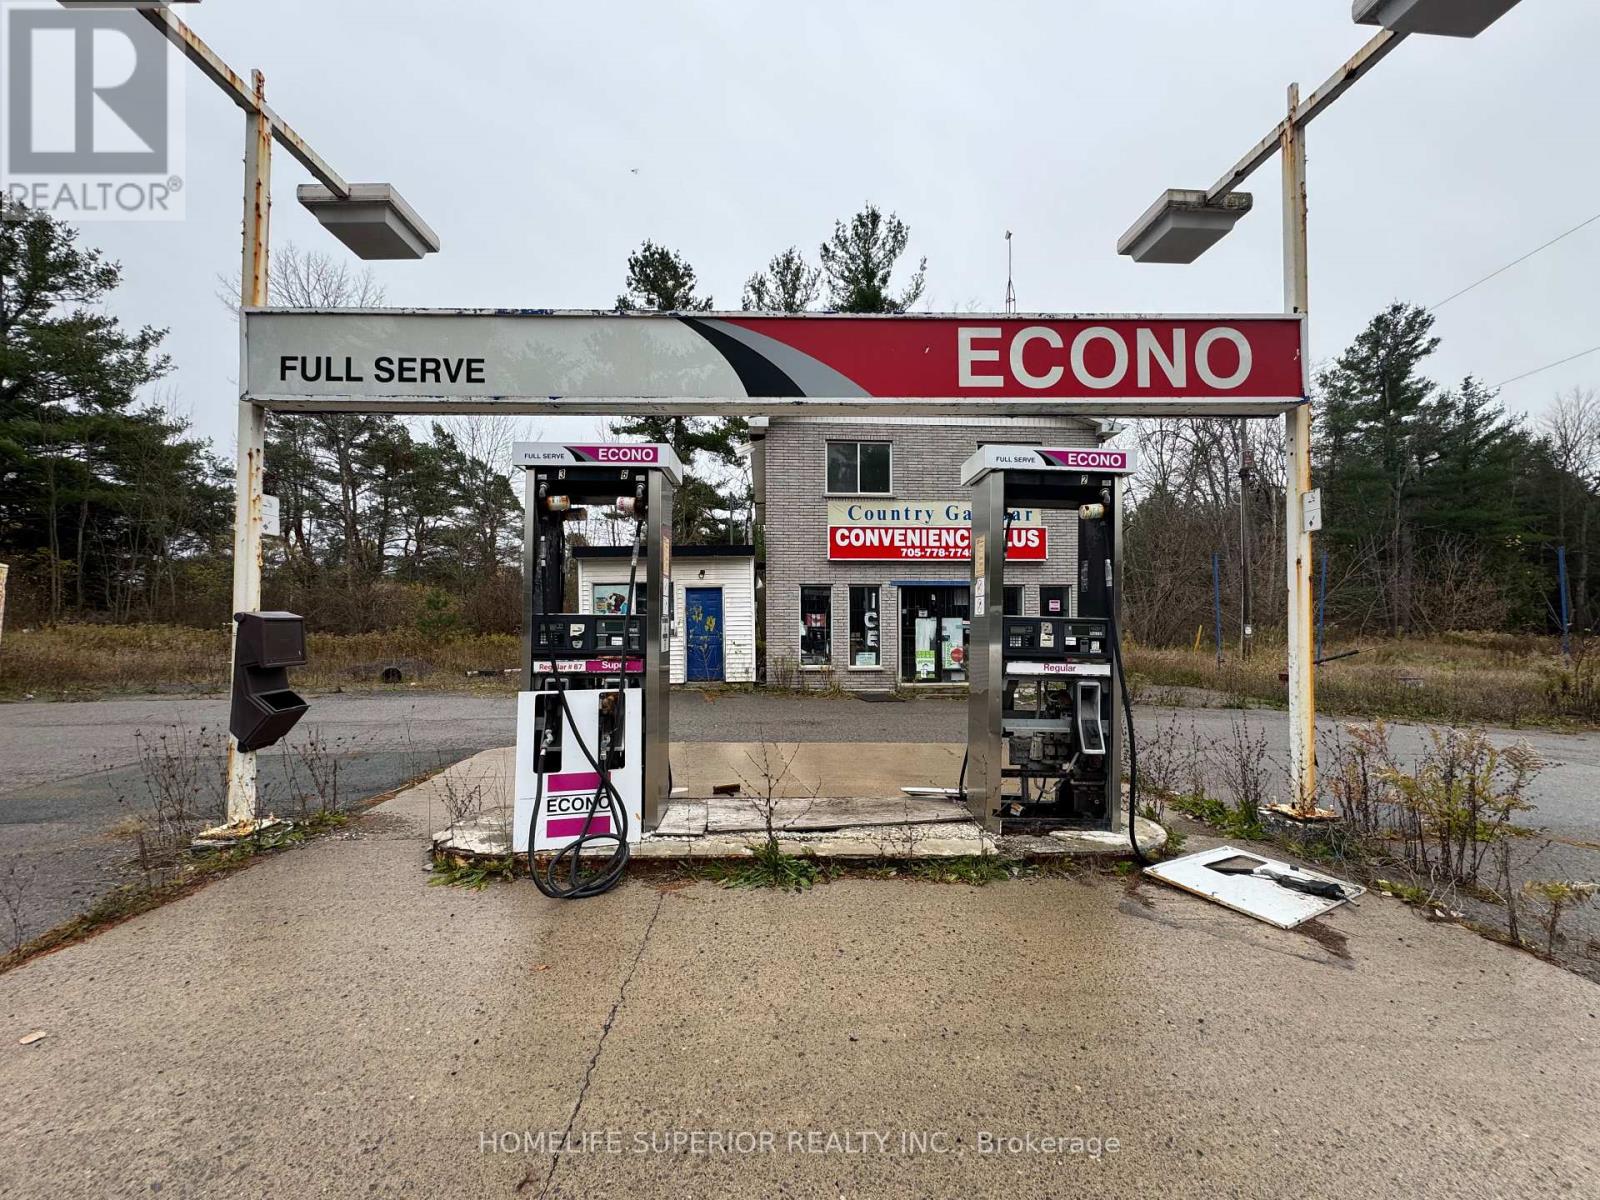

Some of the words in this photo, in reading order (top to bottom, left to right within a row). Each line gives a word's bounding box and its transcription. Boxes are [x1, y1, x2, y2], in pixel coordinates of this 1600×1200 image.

[957, 326, 1253, 390] ECONO
[280, 356, 363, 381] FULL
[374, 357, 485, 383] SERVE
[598, 448, 653, 461] ECONO
[1068, 453, 1121, 467] ECONO
[848, 505, 934, 523] Country
[945, 505, 972, 521] Ga
[1003, 509, 1032, 521] ar
[835, 528, 971, 547] CONVENIENC
[901, 548, 971, 557] 705-778-774
[864, 592, 878, 647] ICE
[539, 663, 566, 671] Reglar
[1043, 663, 1076, 672] Regular
